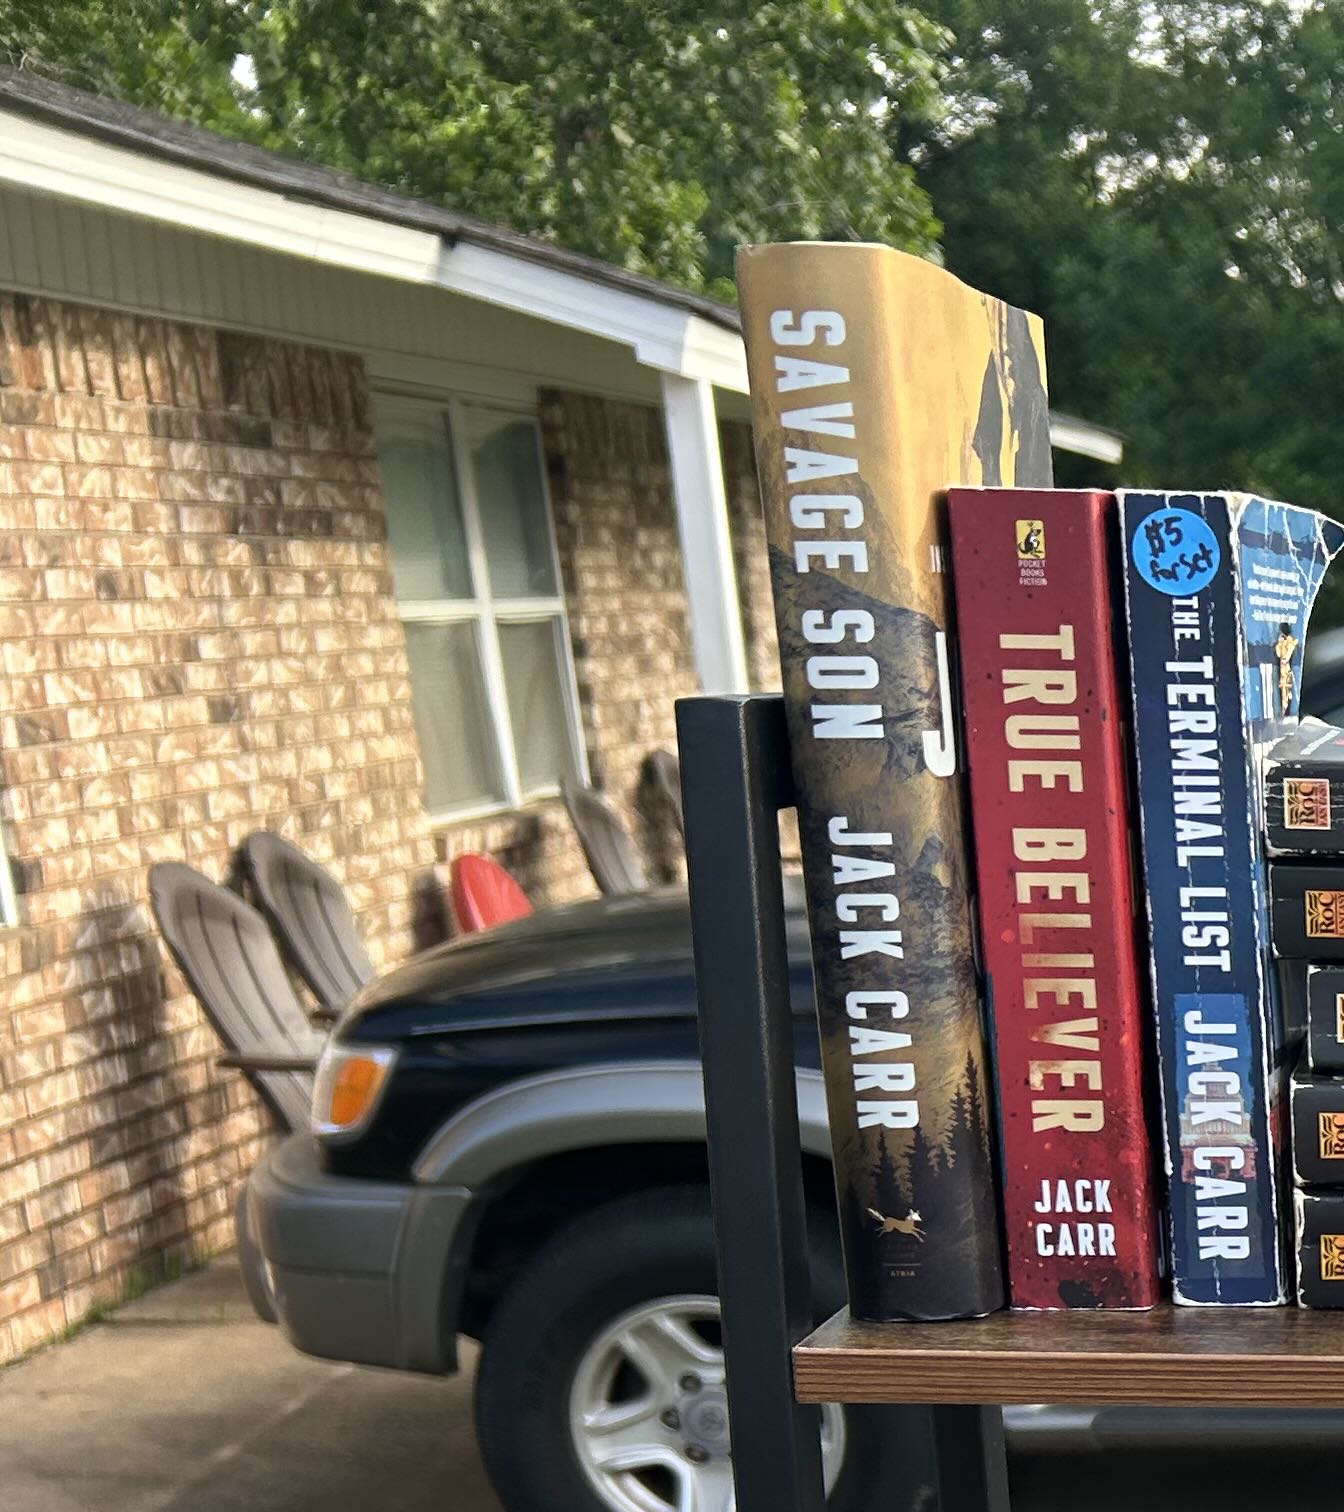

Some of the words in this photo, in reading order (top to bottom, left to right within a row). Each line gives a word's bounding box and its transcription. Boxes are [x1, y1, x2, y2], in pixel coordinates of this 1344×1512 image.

[769, 309, 869, 574] SAVAGE
[801, 609, 885, 740] SON
[1170, 597, 1200, 641] THE
[999, 624, 1085, 793] TRUE
[1165, 655, 1220, 868] TERMINAL
[827, 816, 905, 960] JACK
[1181, 886, 1231, 972] LIST
[1012, 827, 1105, 1134] BELIEVER
[844, 989, 921, 1130] CARR
[1034, 1178, 1113, 1216] JACK
[1035, 1222, 1117, 1258] CARR
